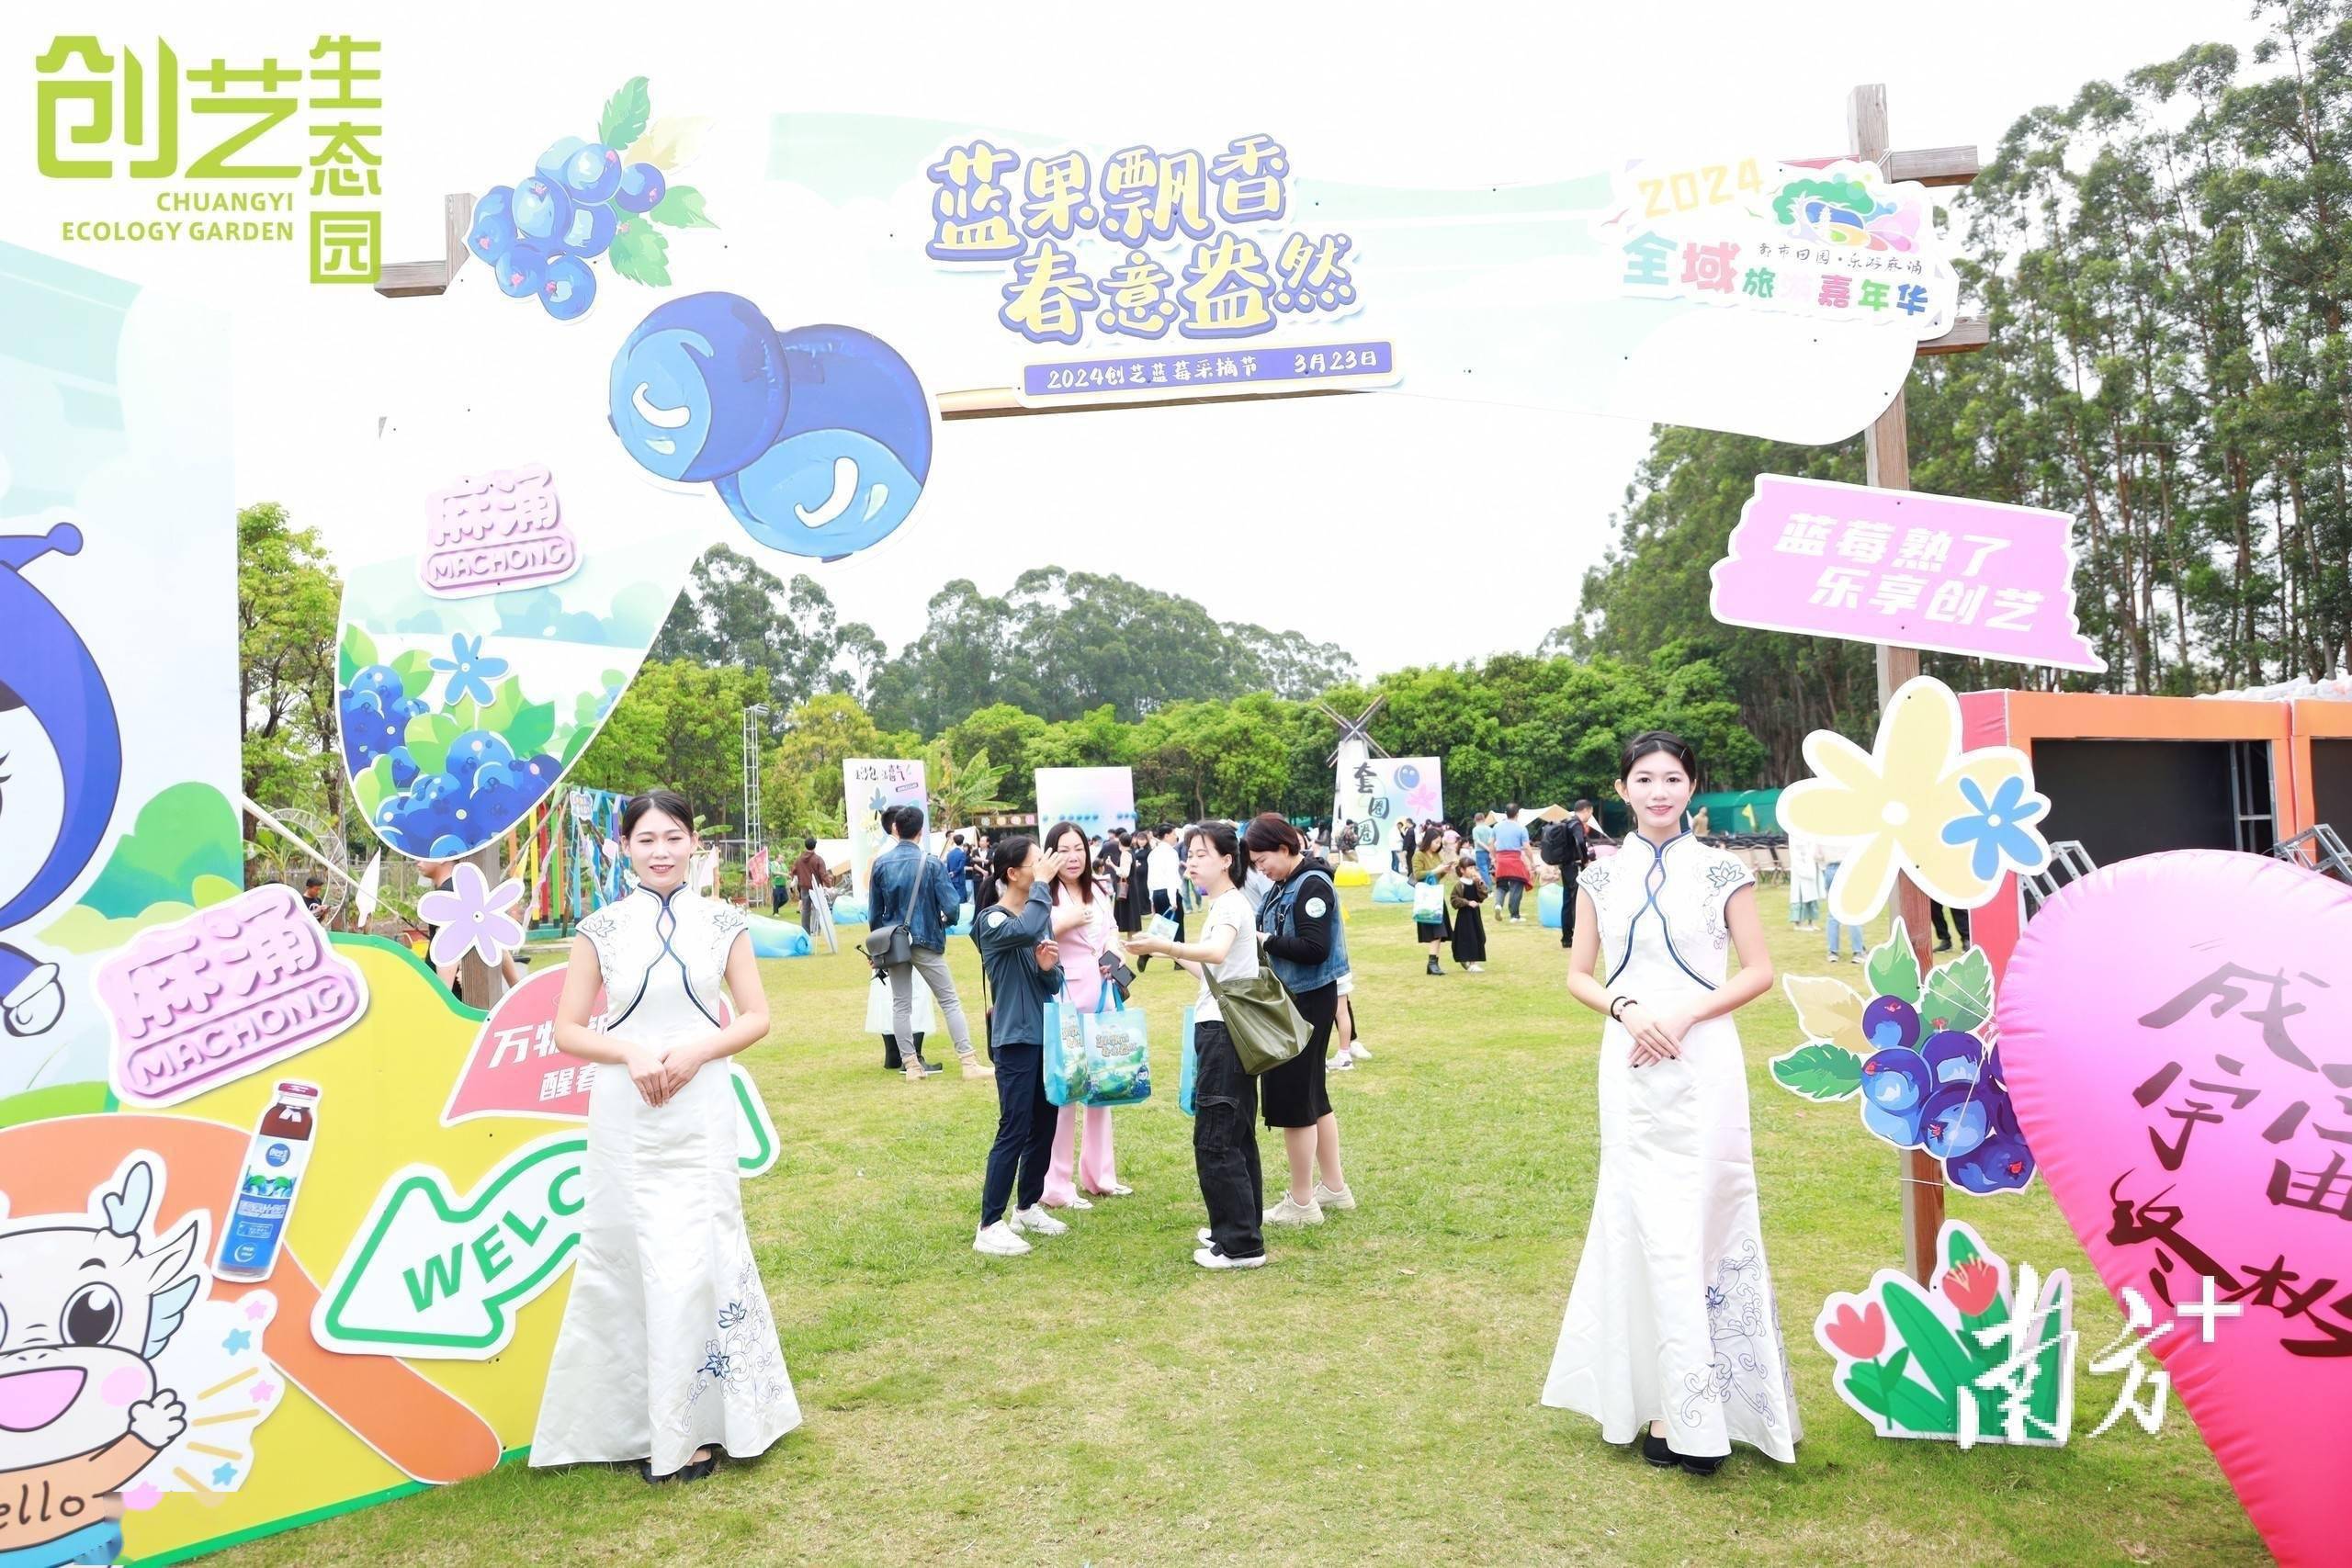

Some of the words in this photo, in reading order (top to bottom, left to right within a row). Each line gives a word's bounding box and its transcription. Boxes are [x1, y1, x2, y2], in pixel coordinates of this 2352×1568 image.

[925, 133, 1290, 261] 蓝果飘香
[1638, 157, 1764, 220] 2024
[999, 231, 1357, 345] 春意盎然
[1046, 355, 1258, 390] 2024创艺蓝莓采摘节
[1294, 349, 1378, 375] 3月23日
[430, 465, 561, 547] 麻涌
[1773, 513, 2012, 577] 蓝莓熟了
[430, 544, 567, 581] MACHONG
[1808, 566, 2045, 632] 乐享创艺
[1353, 761, 1390, 846] 套圈圈
[120, 895, 322, 1039] 麻涌
[138, 981, 345, 1088] MACHONG
[2138, 961, 2352, 1095] 成
[2132, 1053, 2352, 1222] 宇宙
